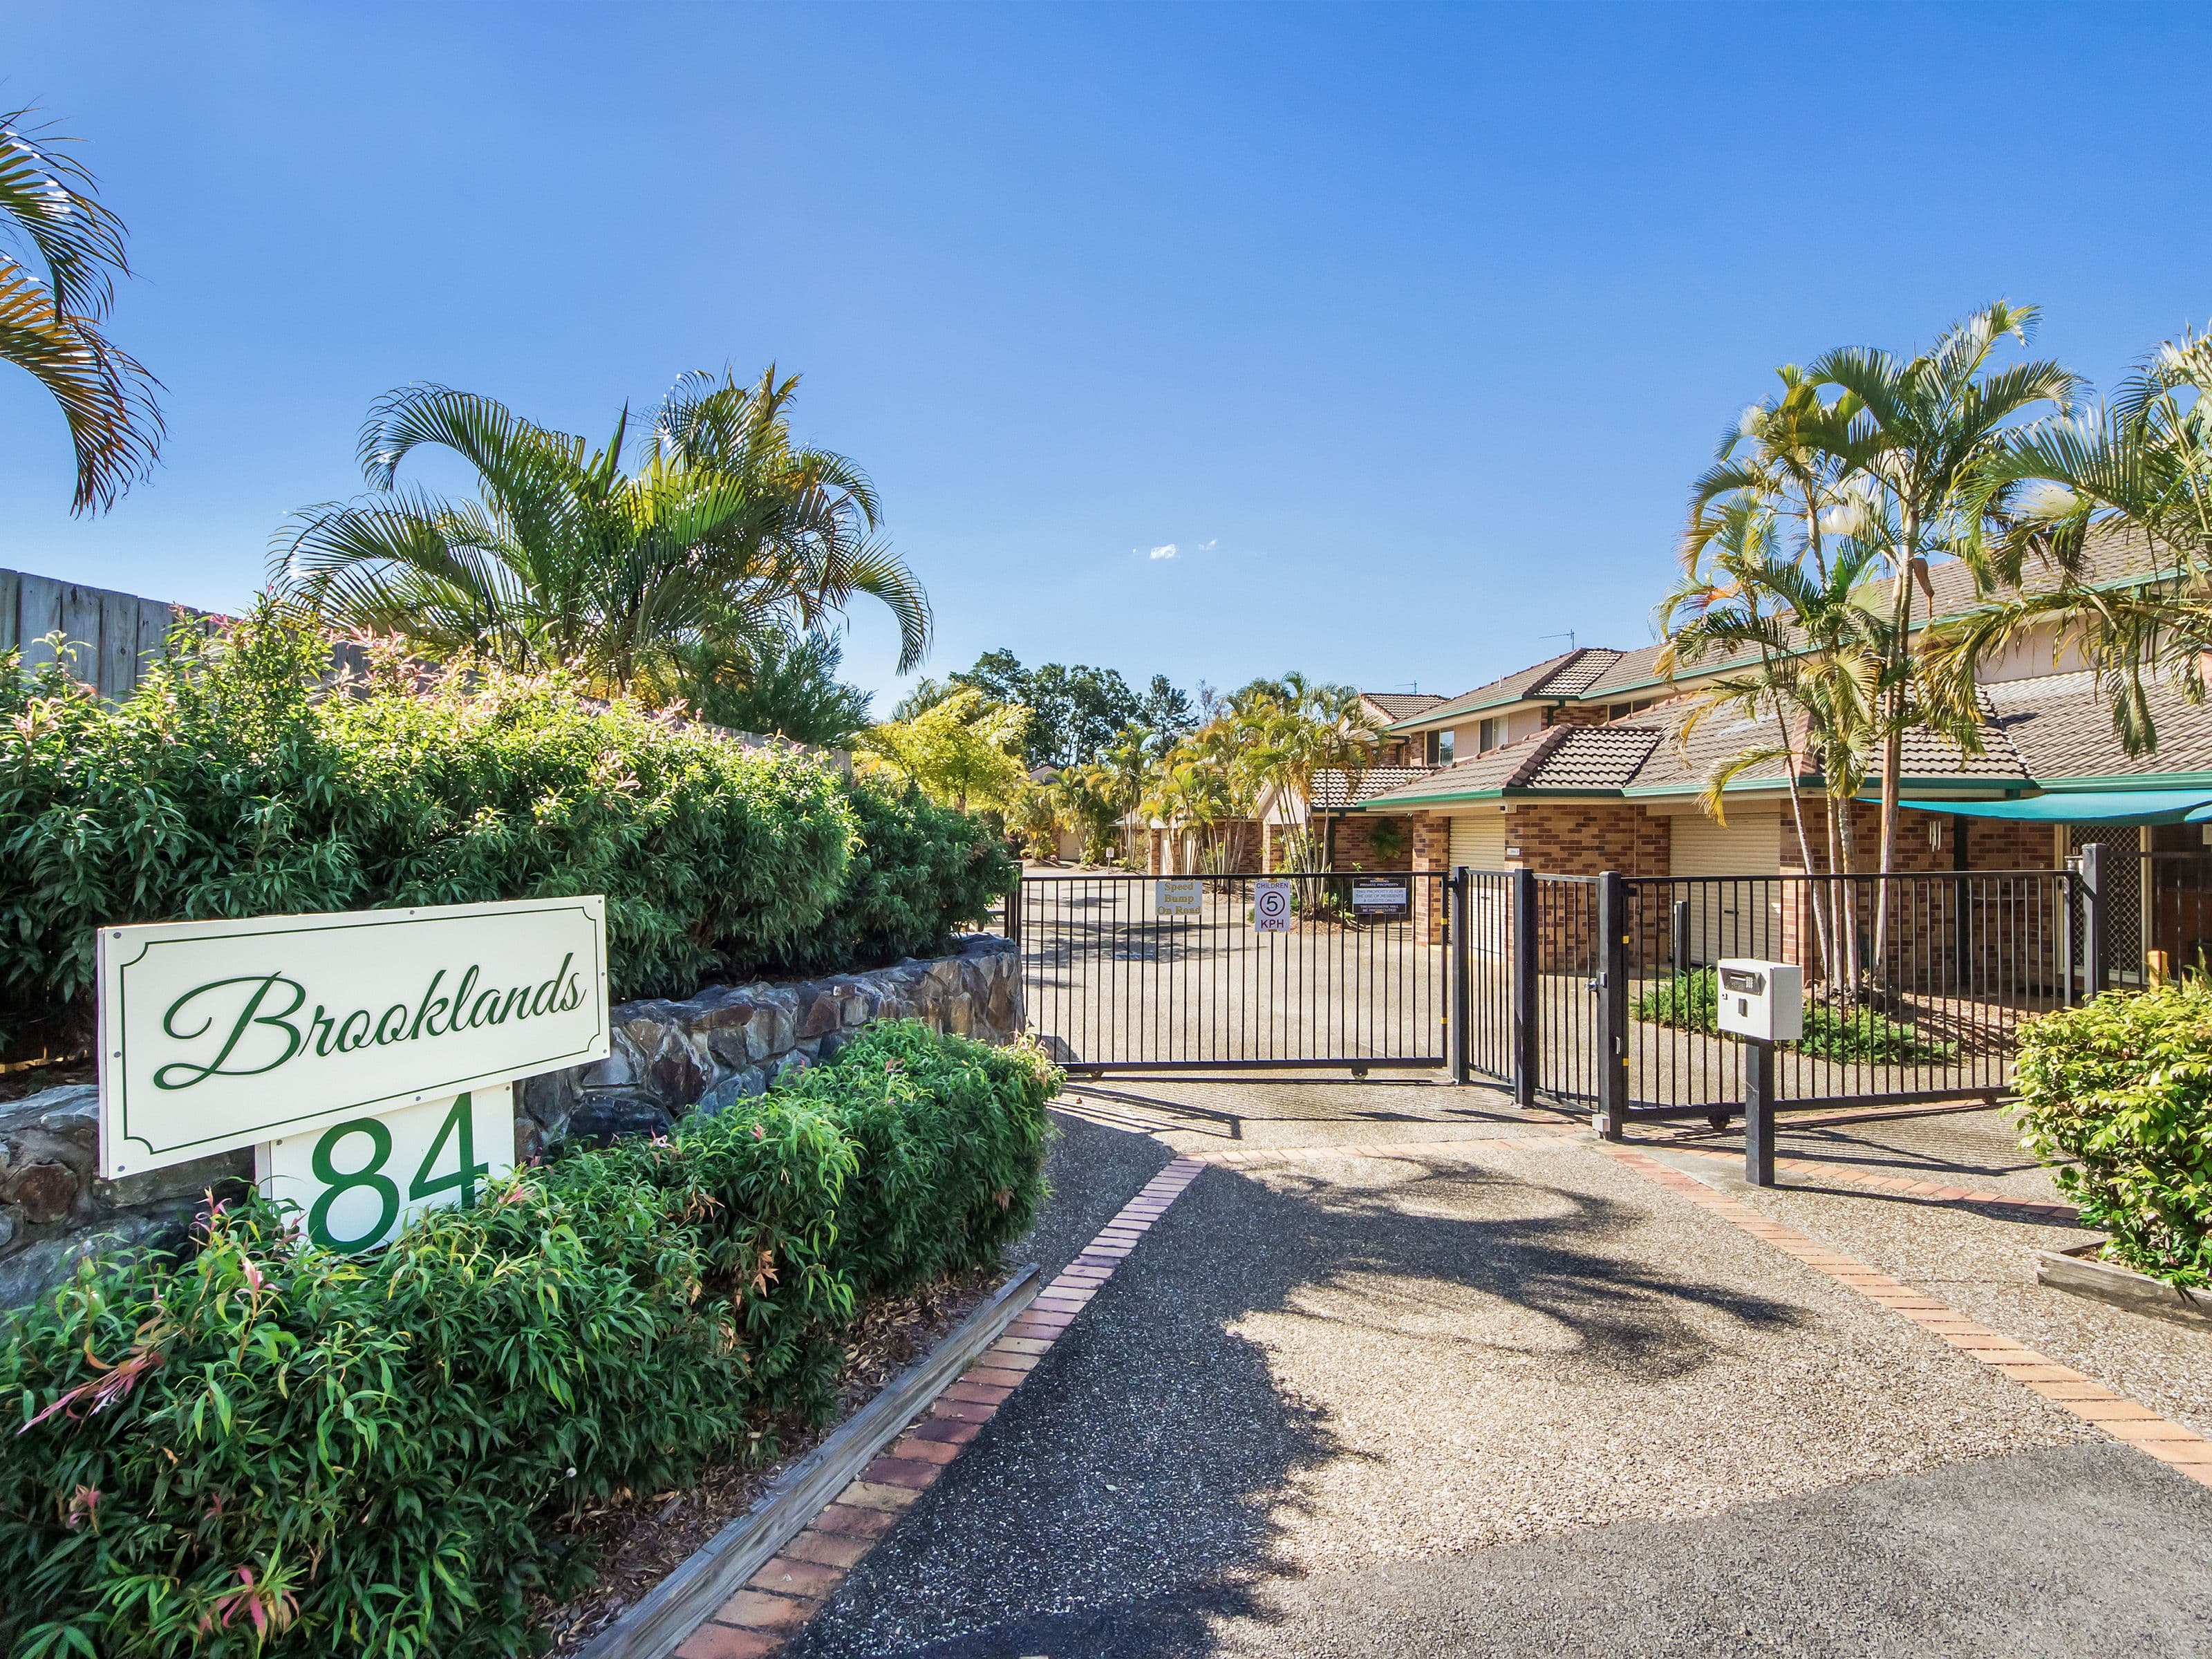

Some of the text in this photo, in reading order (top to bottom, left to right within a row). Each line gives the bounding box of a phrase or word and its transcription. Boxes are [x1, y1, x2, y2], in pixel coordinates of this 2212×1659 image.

[1164, 882, 1194, 892] Speed
[1164, 894, 1194, 904] Bump
[1266, 895, 1278, 912] 5
[1157, 906, 1201, 915] On Road
[1260, 919, 1284, 928] KPH
[153, 952, 587, 1090] Brooklands
[308, 1091, 489, 1255] 84
